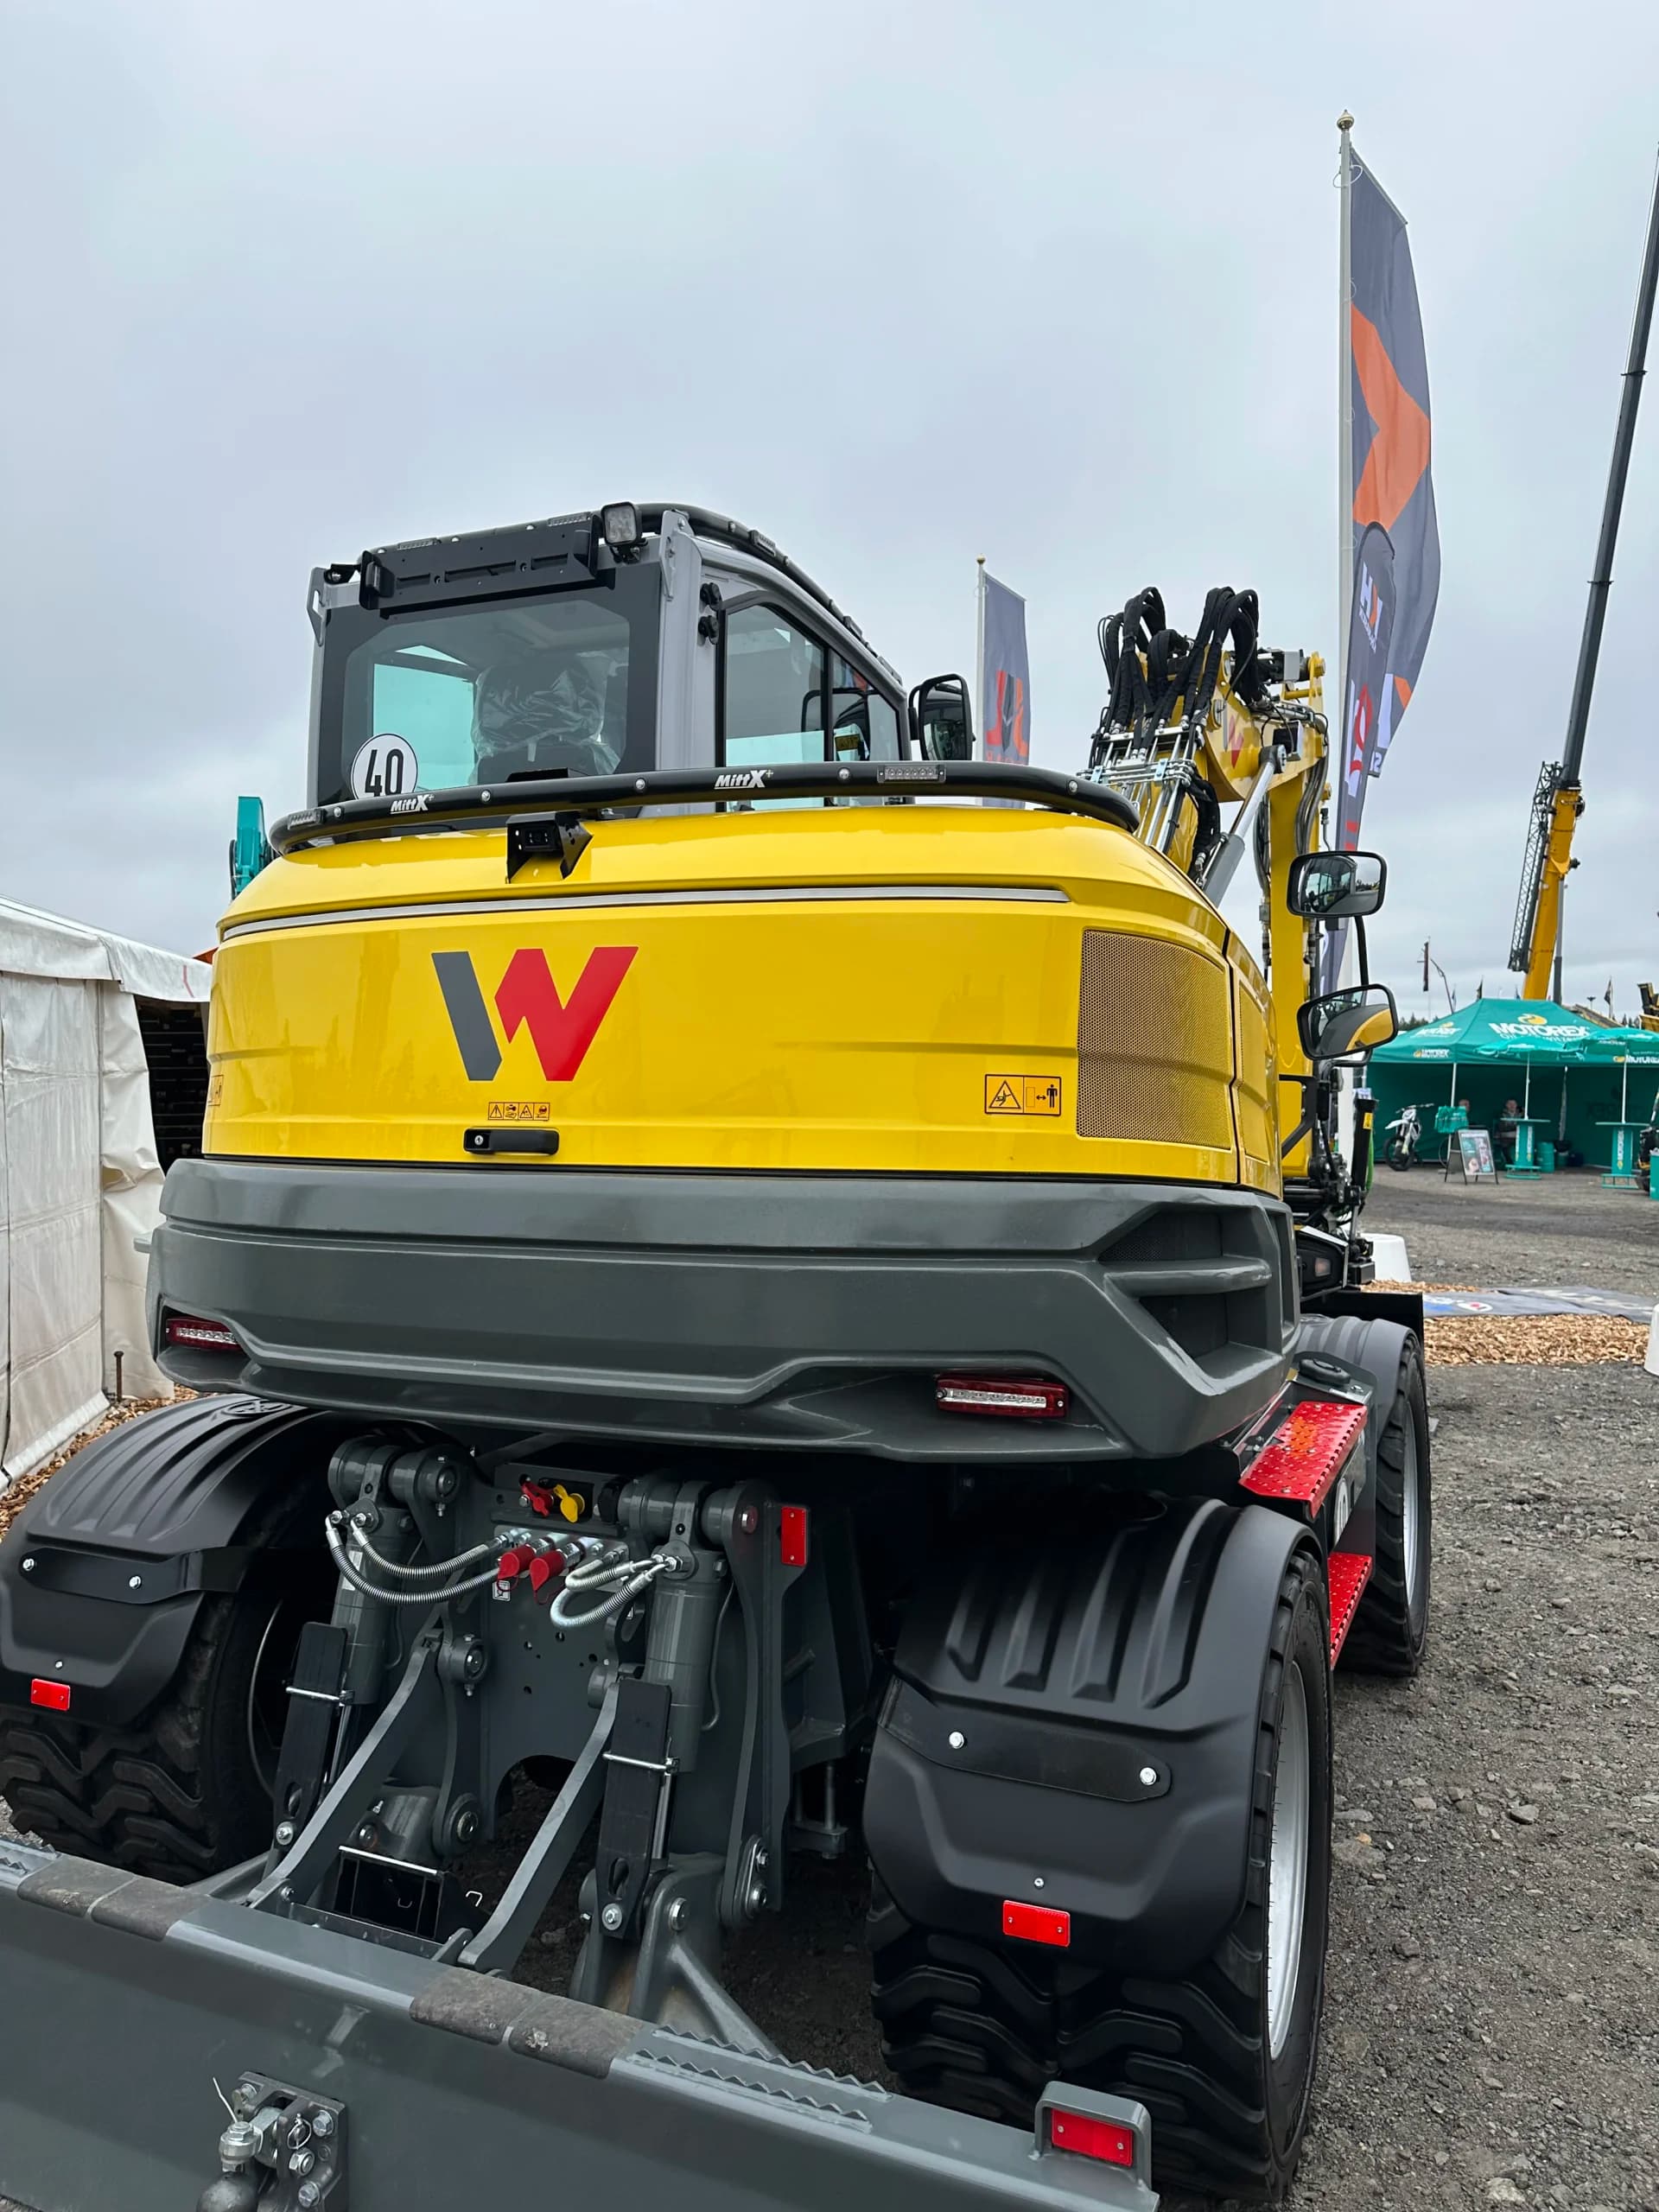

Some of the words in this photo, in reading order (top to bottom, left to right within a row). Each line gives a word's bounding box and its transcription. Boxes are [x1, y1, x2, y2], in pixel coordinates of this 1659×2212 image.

[365, 748, 404, 797] 40
[431, 946, 639, 1082] W
[1488, 1023, 1590, 1037] MOTOREX
[1421, 1048, 1450, 1058] MOTOREX
